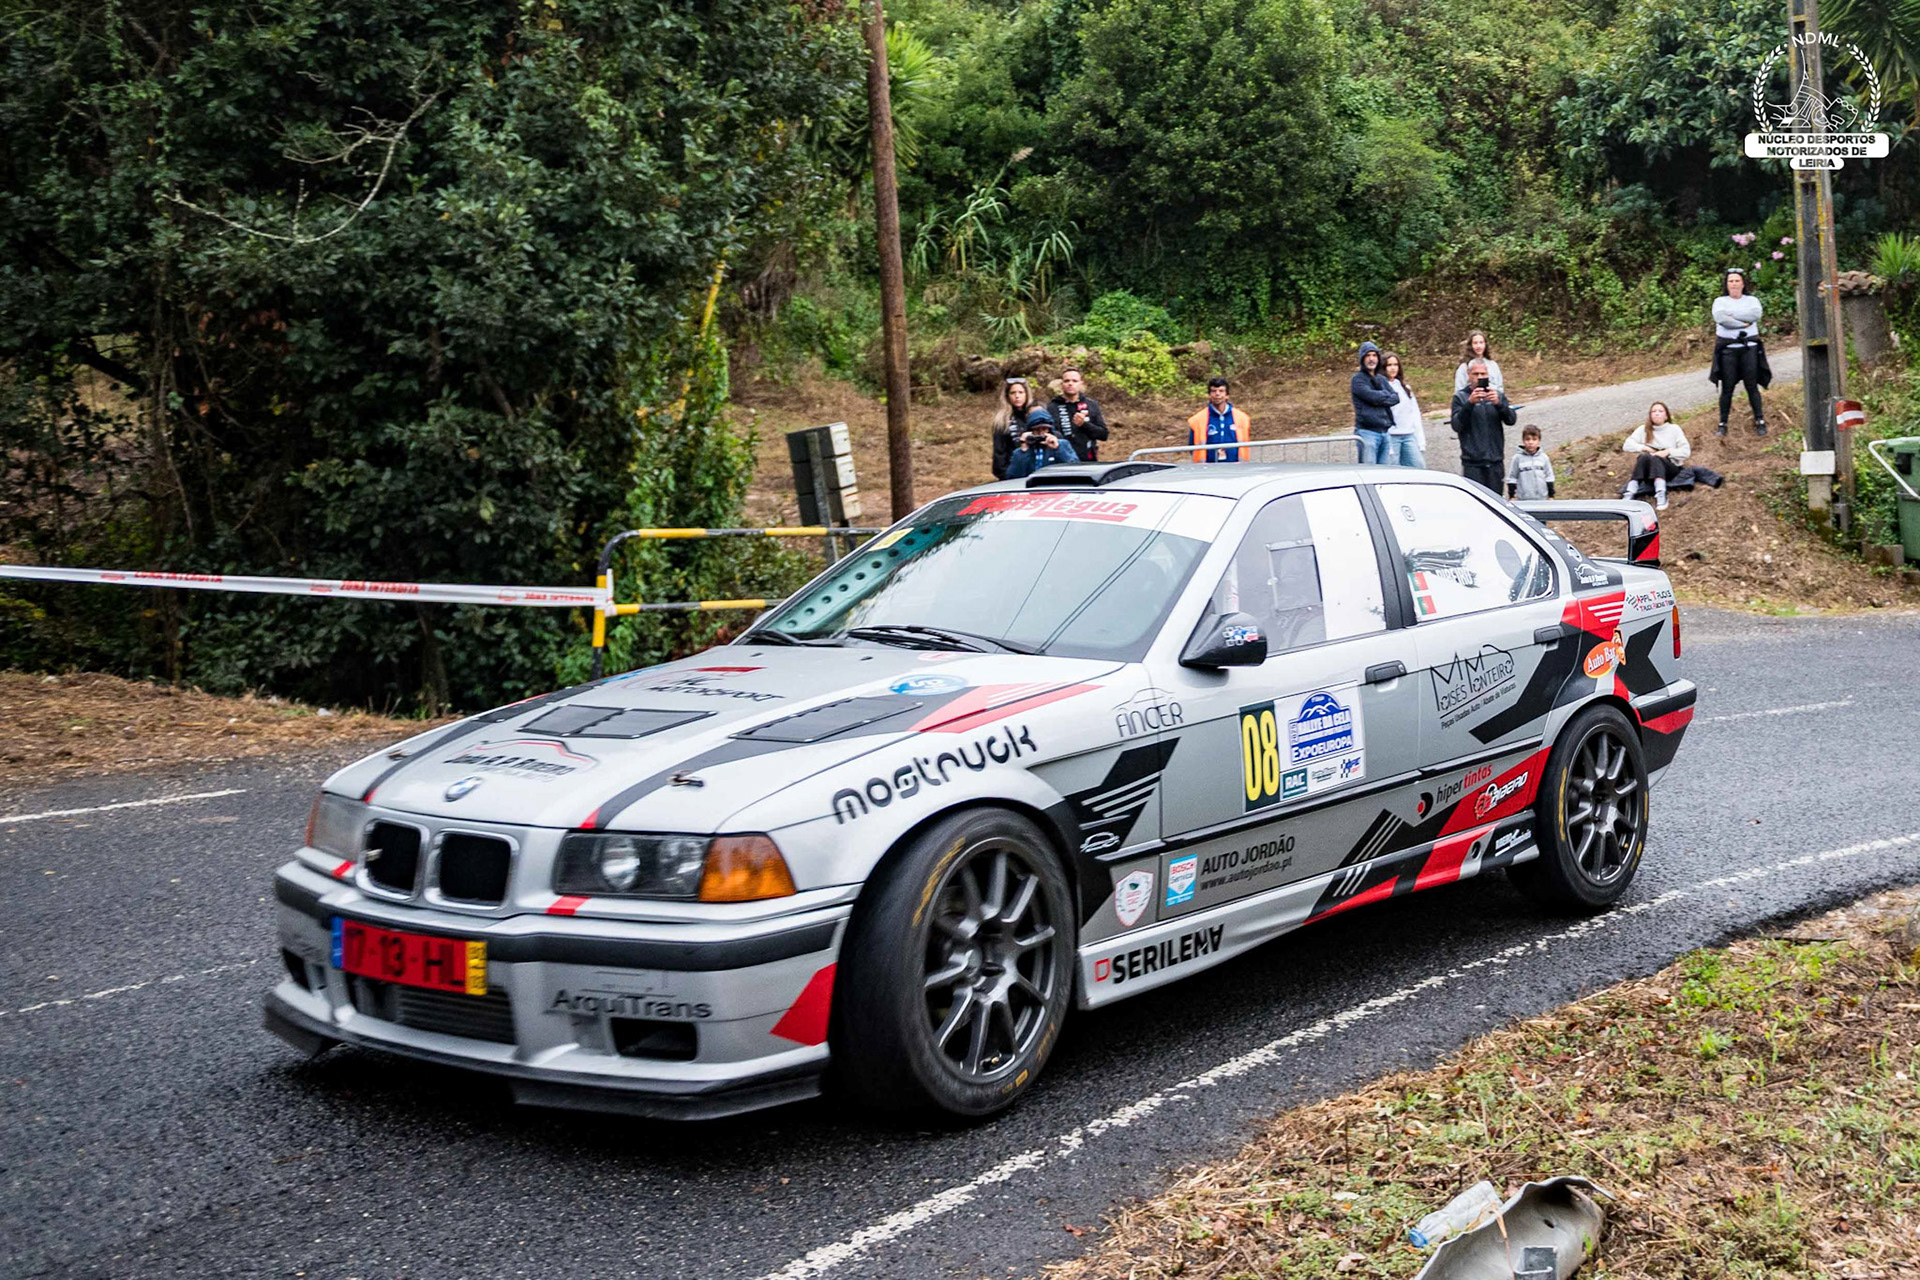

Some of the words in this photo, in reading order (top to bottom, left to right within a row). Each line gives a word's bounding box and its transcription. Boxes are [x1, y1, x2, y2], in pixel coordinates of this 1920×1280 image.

[1588, 653, 1604, 672] Auto
[1242, 710, 1280, 801] 08
[1284, 772, 1306, 791] RAC
[1201, 850, 1239, 876] AUTO
[1241, 833, 1296, 865] JORDÃO
[1201, 857, 1293, 891] www.autojordao.pt
